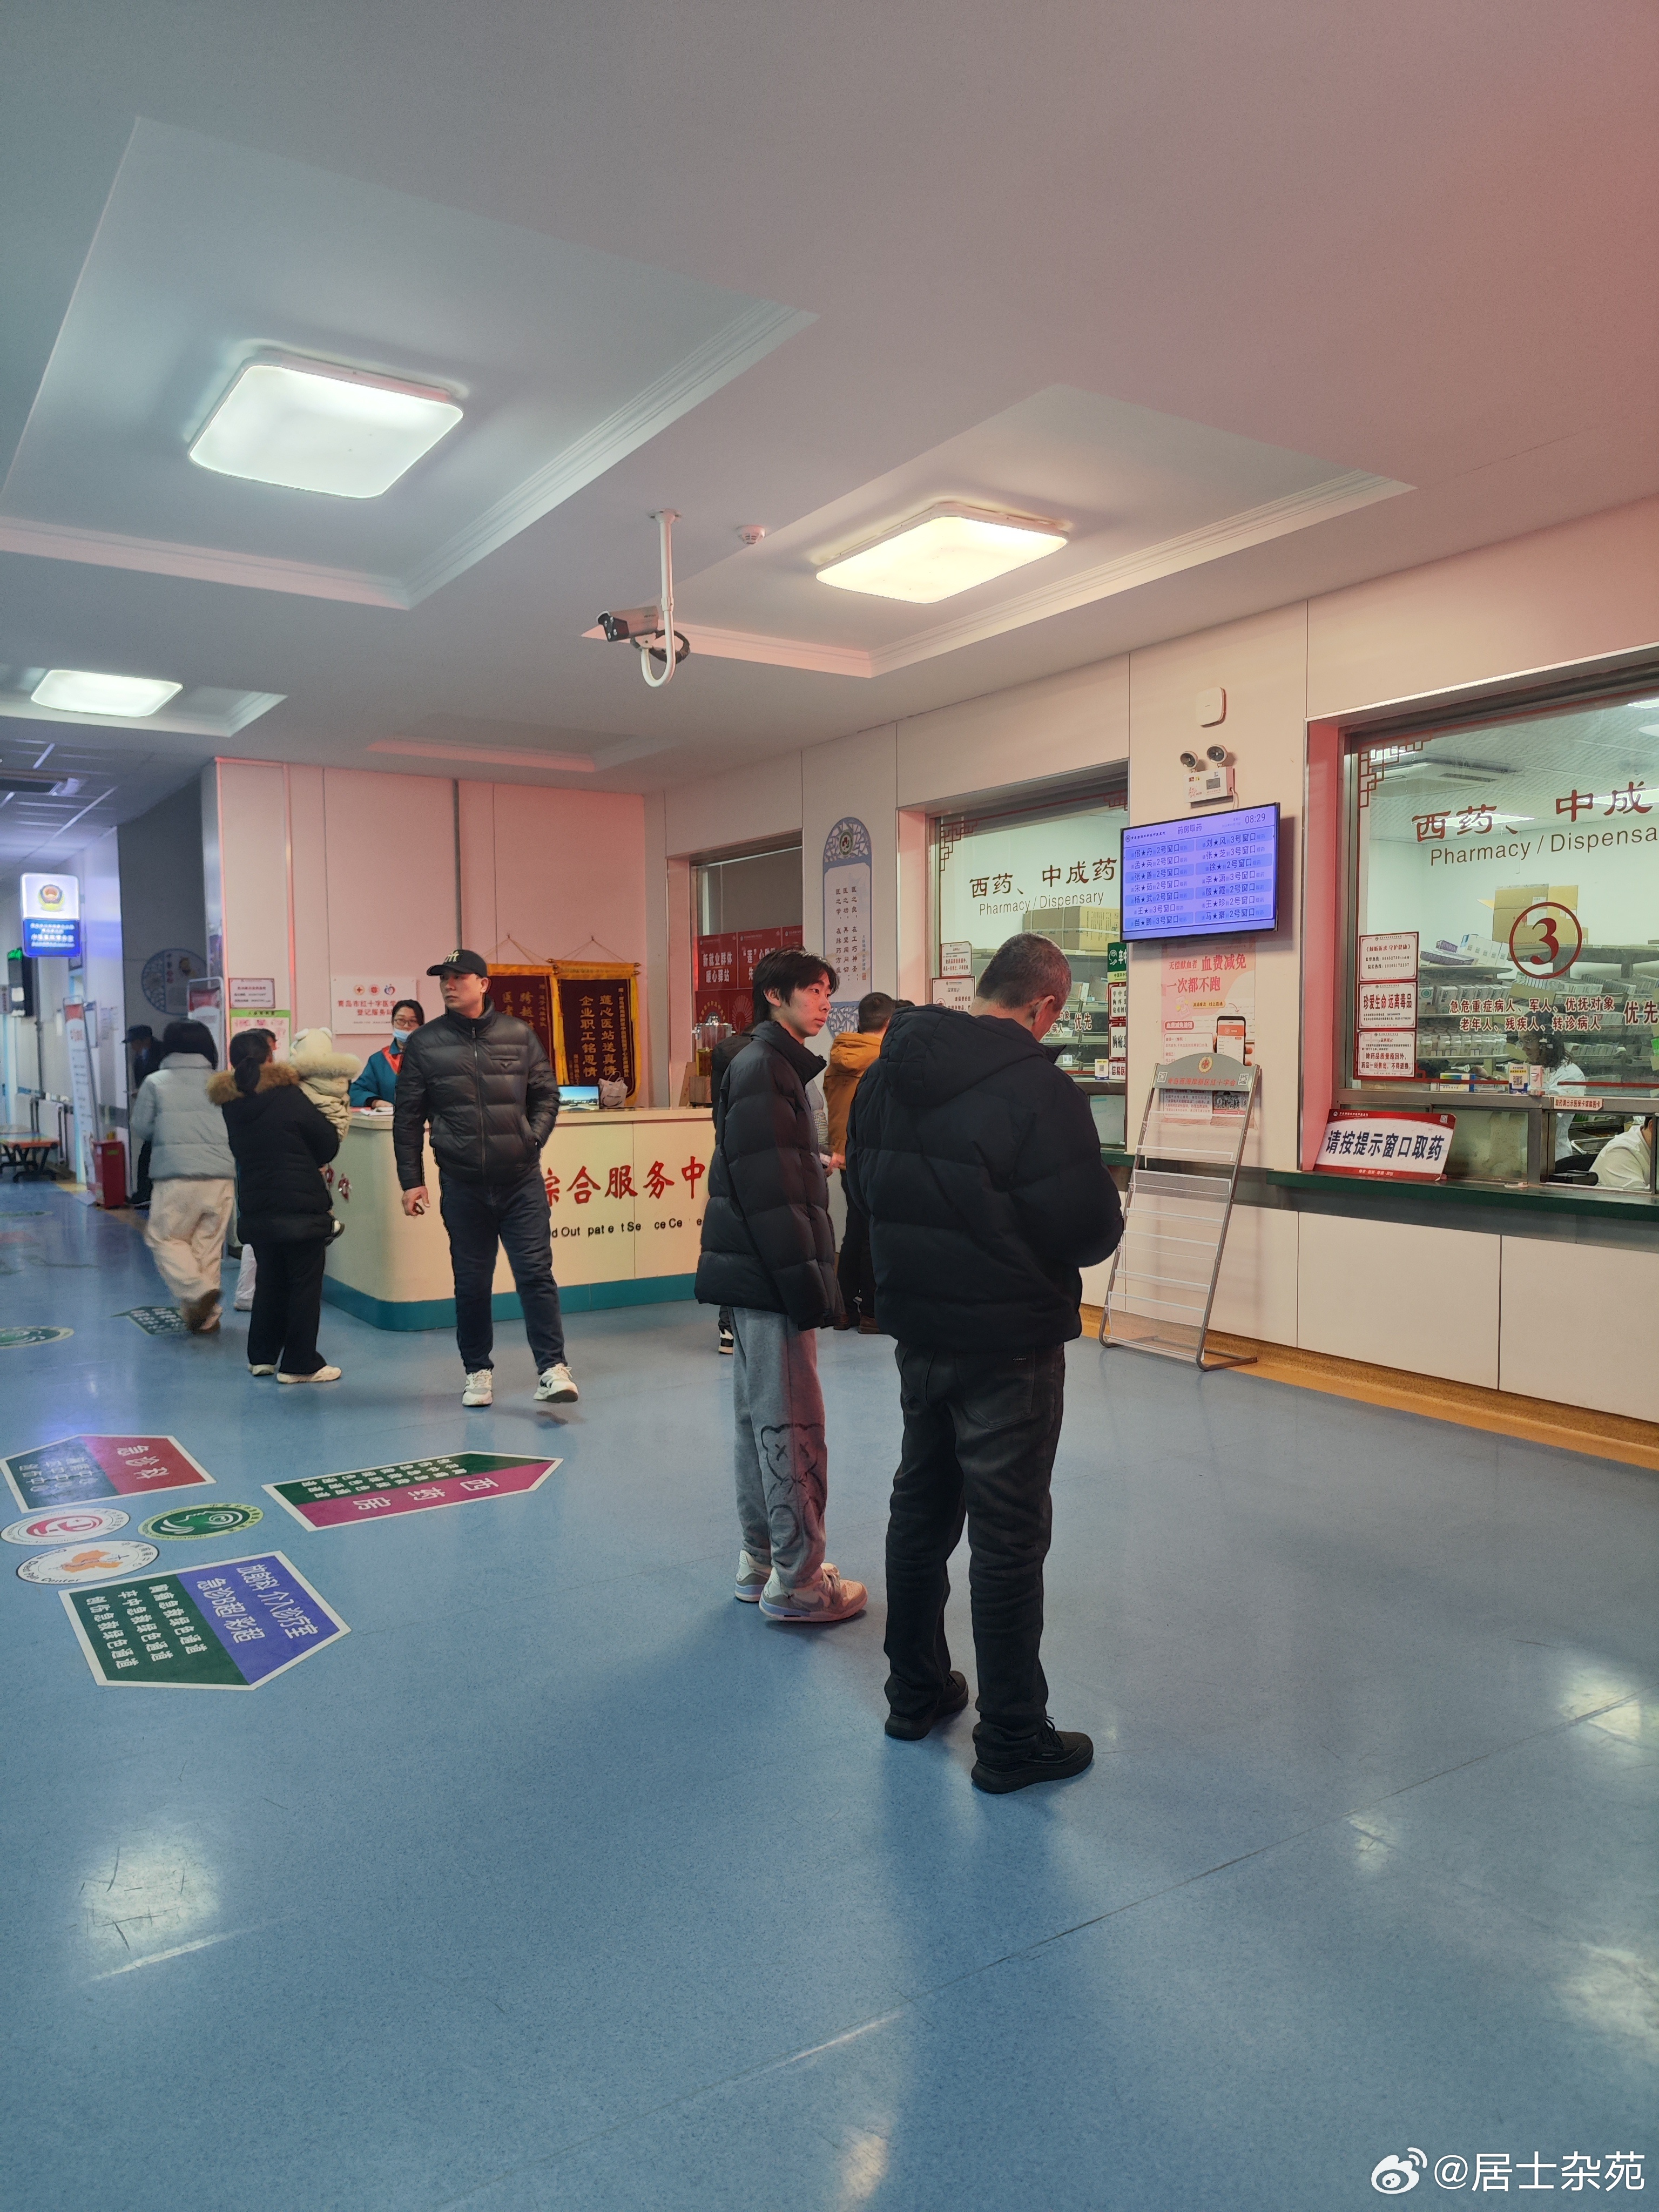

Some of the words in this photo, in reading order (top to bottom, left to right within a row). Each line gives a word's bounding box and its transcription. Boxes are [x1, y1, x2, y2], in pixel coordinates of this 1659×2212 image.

[1245, 813, 1266, 824] 08:29
[1411, 804, 1519, 842] 西药、
[1555, 781, 1654, 822] 中成
[1177, 824, 1203, 834] 药房取药
[1431, 840, 1531, 866] Pharmacy
[1550, 826, 1657, 853] Dispensa
[969, 873, 1024, 899] 西药、
[1042, 857, 1117, 888] 中成药
[979, 900, 1030, 916] Pharmacy
[1040, 892, 1104, 910] Dispensary
[1529, 918, 1560, 966] 3
[703, 951, 732, 967] 新就业群体
[1169, 960, 1198, 970] 无偿献血者
[1201, 953, 1246, 972] 血费减免
[706, 968, 730, 983] 暖心驿站
[1166, 976, 1220, 994] 一次都不跑
[1363, 994, 1386, 1010] 珍爱生命
[1388, 993, 1412, 1009] 远离毒品
[1074, 1012, 1092, 1031] 优先
[1459, 1015, 1602, 1033] 老年人、残疾人、转诊病人
[1325, 1129, 1445, 1161] 请按提示窗口取药
[117, 1445, 169, 1480] 急诊科
[352, 1477, 500, 1510] 西药房
[236, 1563, 279, 1591] 放射科
[118, 1589, 174, 1662] 卒中急救绿色通道
[149, 1583, 208, 1655] 胸痛急救绿色通道
[196, 1577, 266, 1643] 急诊B超/彩超
[257, 1590, 319, 1640] 介入诊疗室
[85, 1595, 139, 1670] 创伤急救绿色通道
